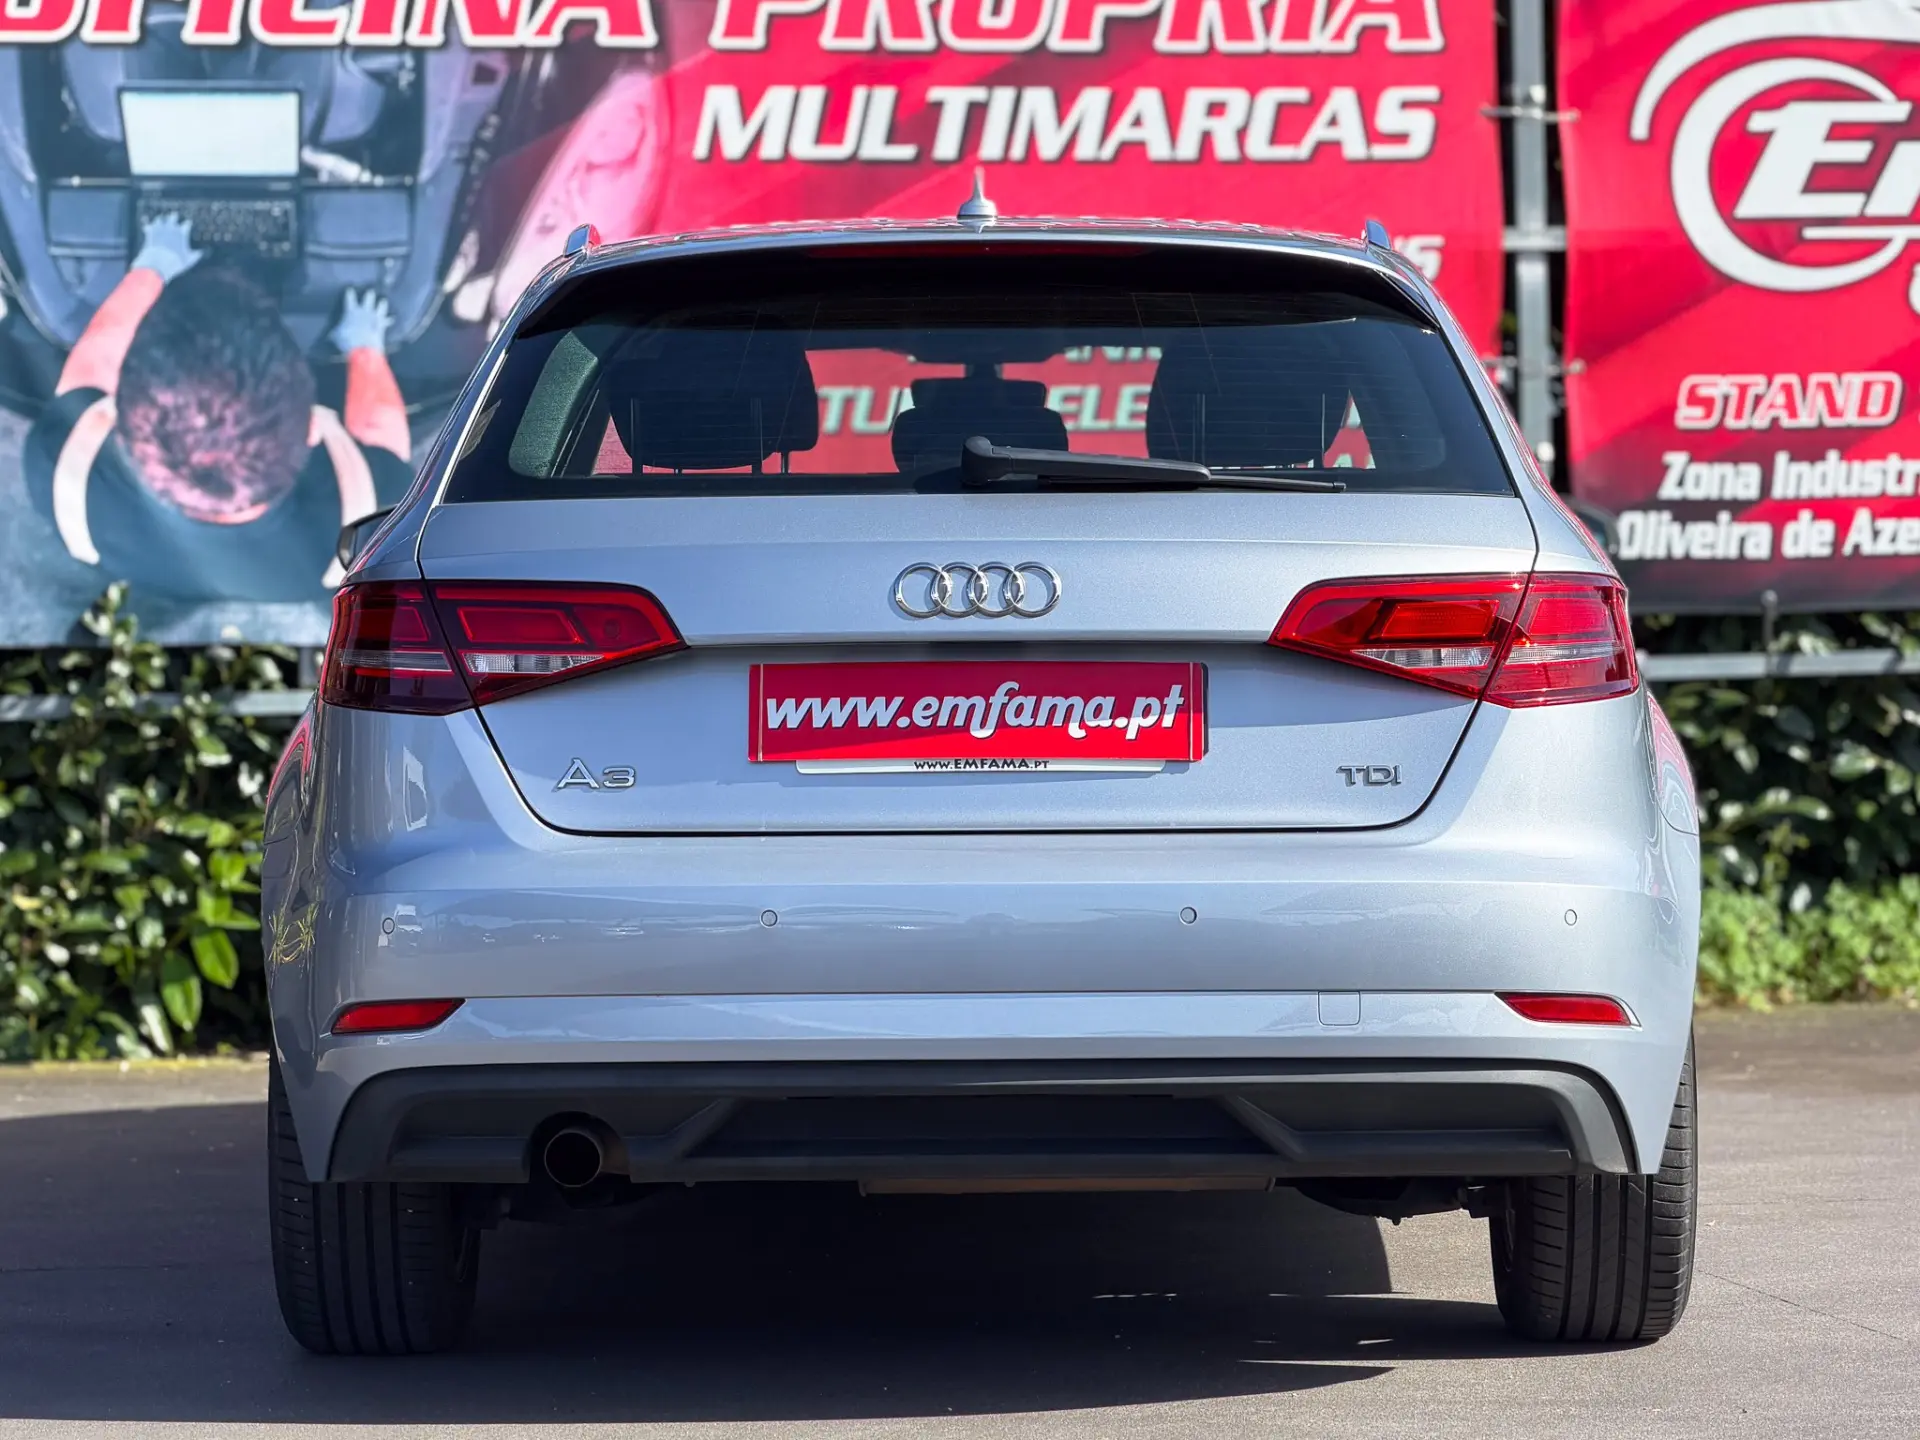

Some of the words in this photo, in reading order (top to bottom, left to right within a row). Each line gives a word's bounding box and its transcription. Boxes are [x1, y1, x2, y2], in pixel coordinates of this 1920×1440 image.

[692, 85, 1442, 161] MULTIMARCAS
[1674, 371, 1903, 428] STAND
[1657, 450, 1762, 500] Zona
[1617, 510, 1773, 560] Oliveira
[1781, 508, 1836, 558] de
[766, 681, 1184, 740] www.emfama.pt
[556, 757, 636, 789] A3
[1337, 764, 1402, 786] TDI
